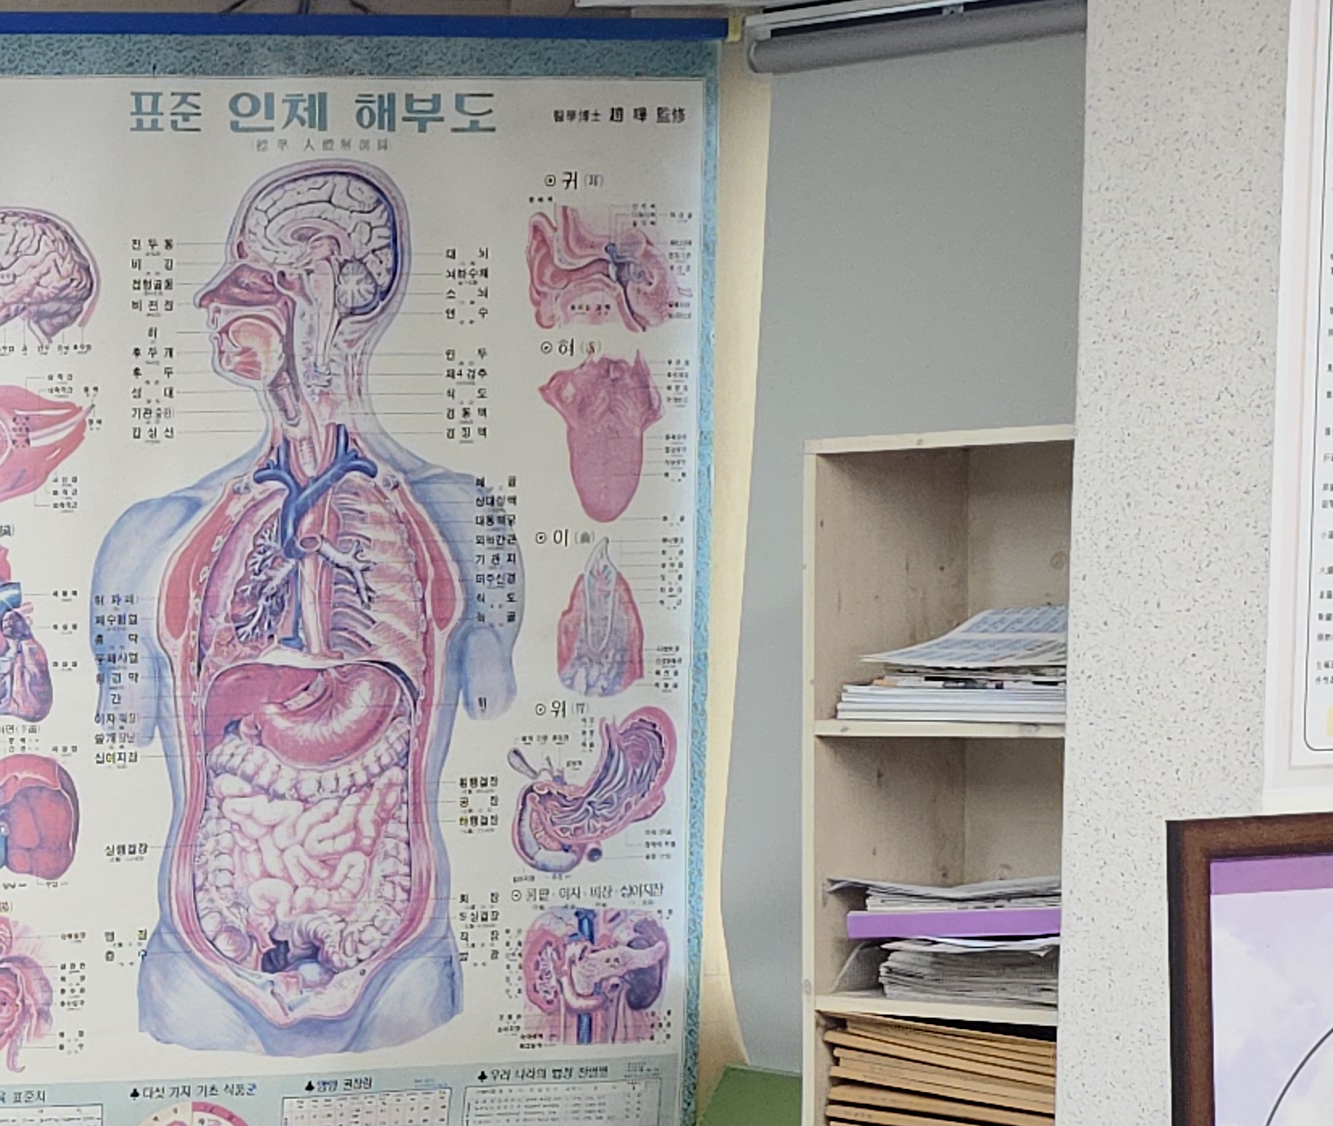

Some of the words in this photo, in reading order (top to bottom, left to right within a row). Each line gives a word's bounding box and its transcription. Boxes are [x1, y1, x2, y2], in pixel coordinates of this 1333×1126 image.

[128, 91, 202, 133] 표준
[227, 91, 329, 133] 인체
[353, 92, 498, 133] 해부도
[561, 171, 578, 190] 귀
[552, 528, 570, 547] 이
[550, 699, 567, 719] 위
